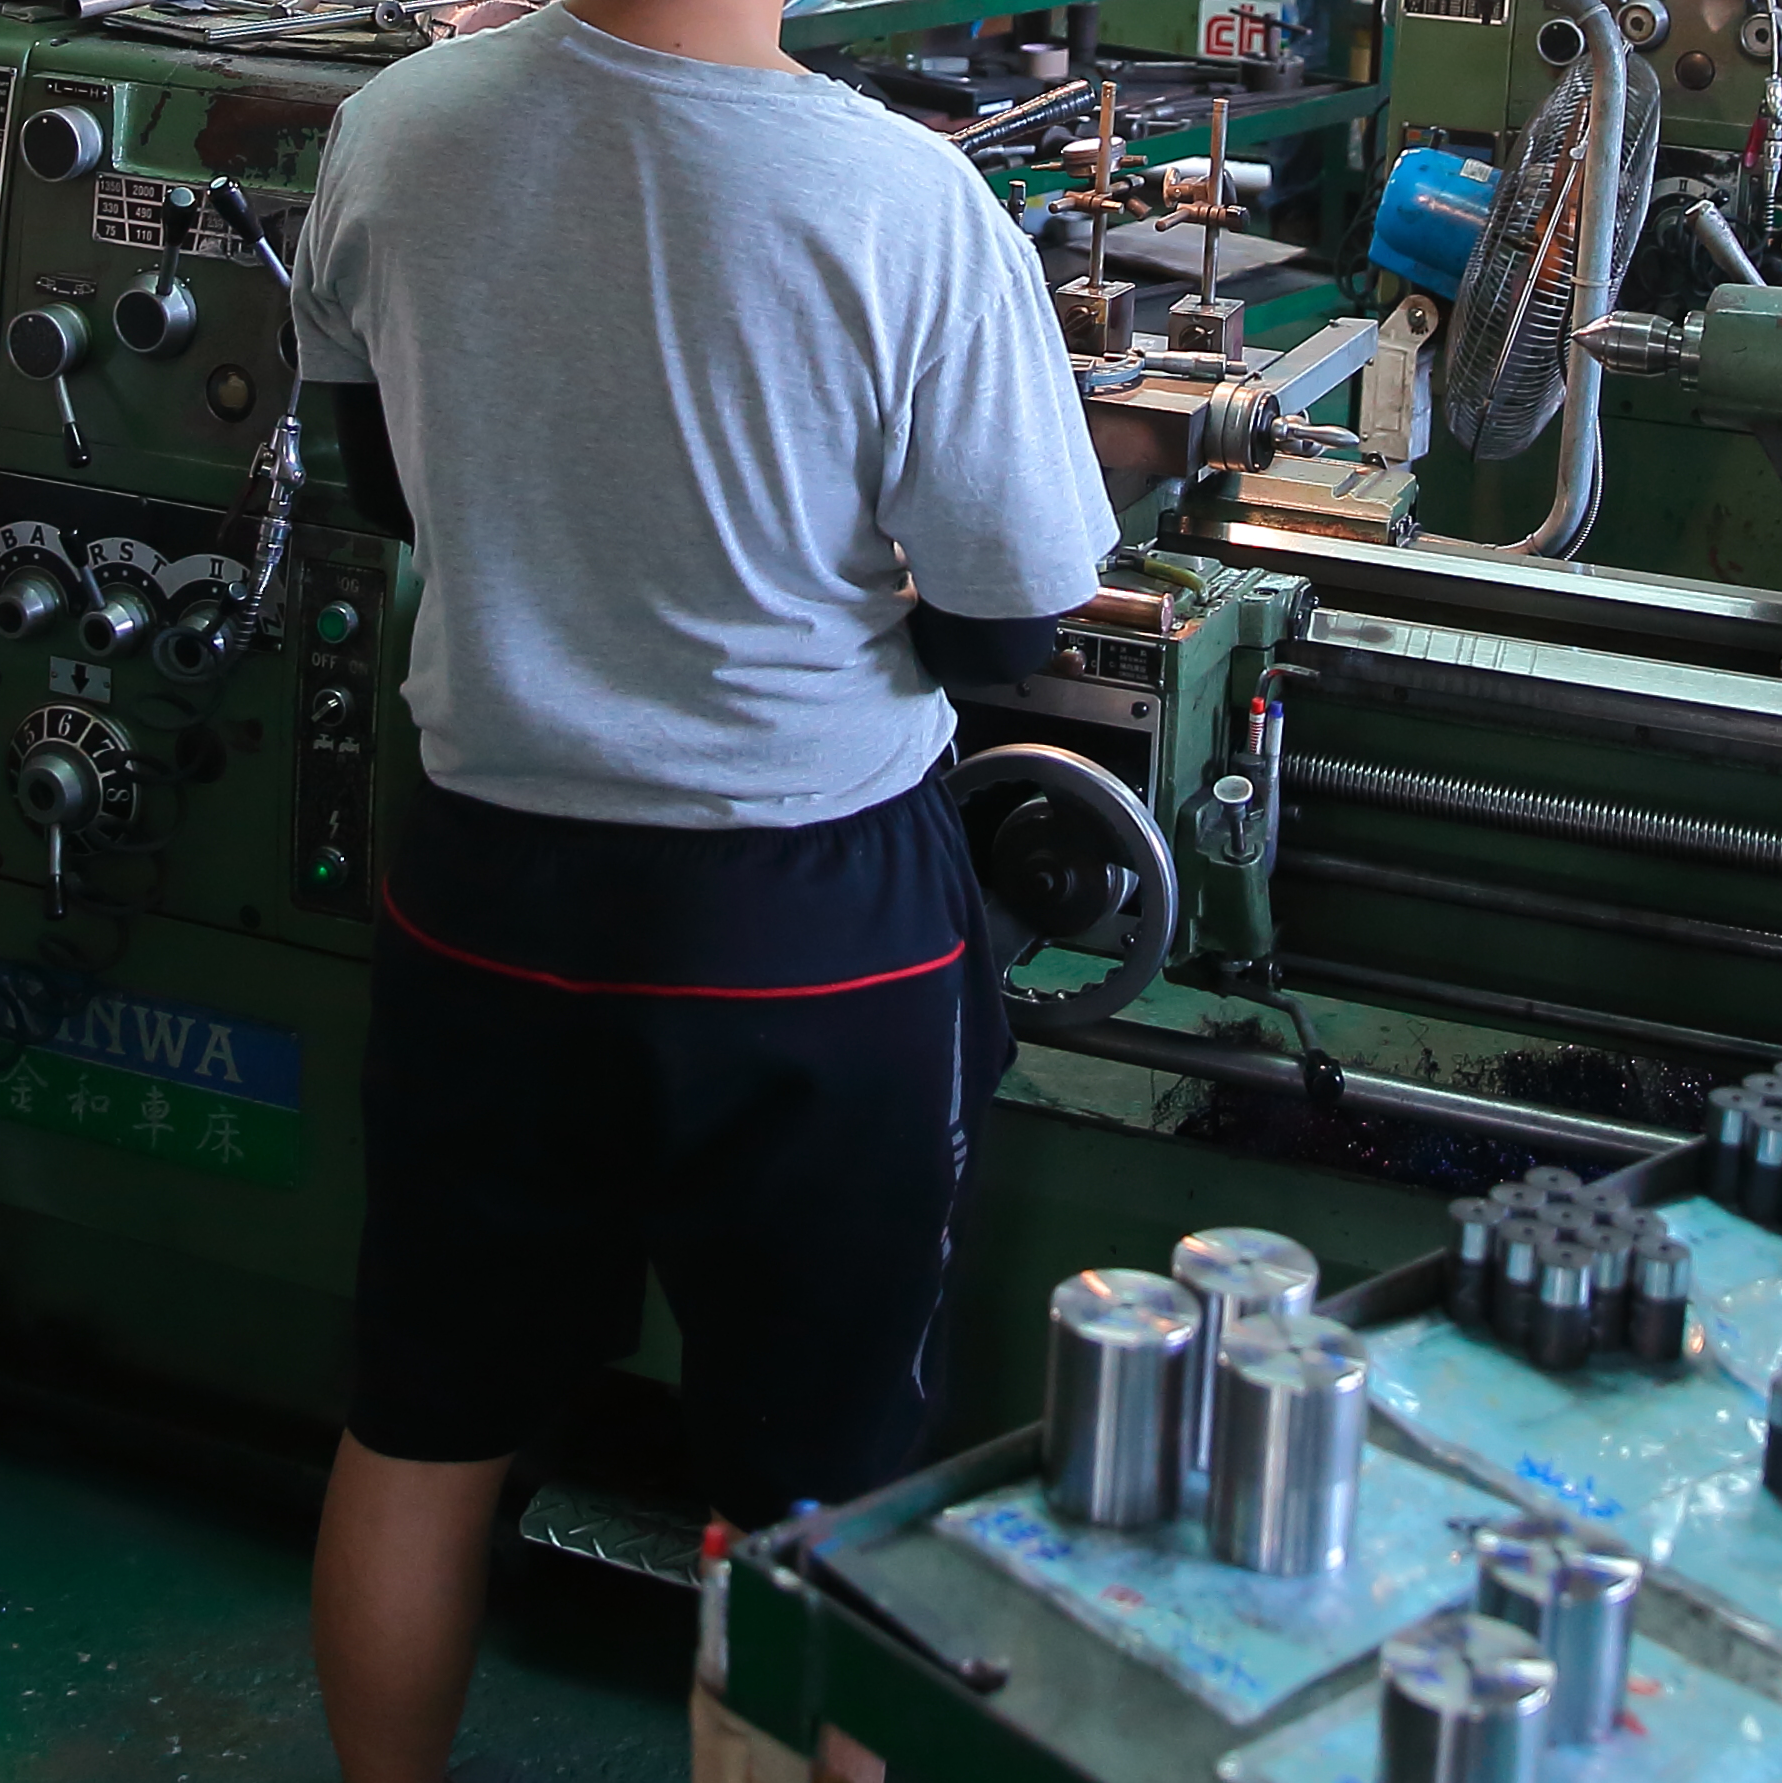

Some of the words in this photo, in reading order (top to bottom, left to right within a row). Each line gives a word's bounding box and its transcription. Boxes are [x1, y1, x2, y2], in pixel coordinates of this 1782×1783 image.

[100, 179, 121, 194] 1350
[132, 185, 155, 198] 2000
[102, 202, 119, 214] 330
[135, 207, 153, 219] 490
[105, 224, 116, 236] 75
[136, 229, 152, 241] 110
[0, 527, 17, 550] B
[29, 525, 45, 546] A
[89, 543, 109, 565] R
[119, 541, 134, 562] S
[152, 554, 167, 576] T
[337, 576, 361, 593] OG
[311, 652, 338, 669] OFF
[24, 722, 36, 746] 5
[58, 713, 73, 737] 6
[92, 738, 116, 758] 7
[105, 787, 130, 802] 8
[0, 1054, 245, 1165] 金和車床
